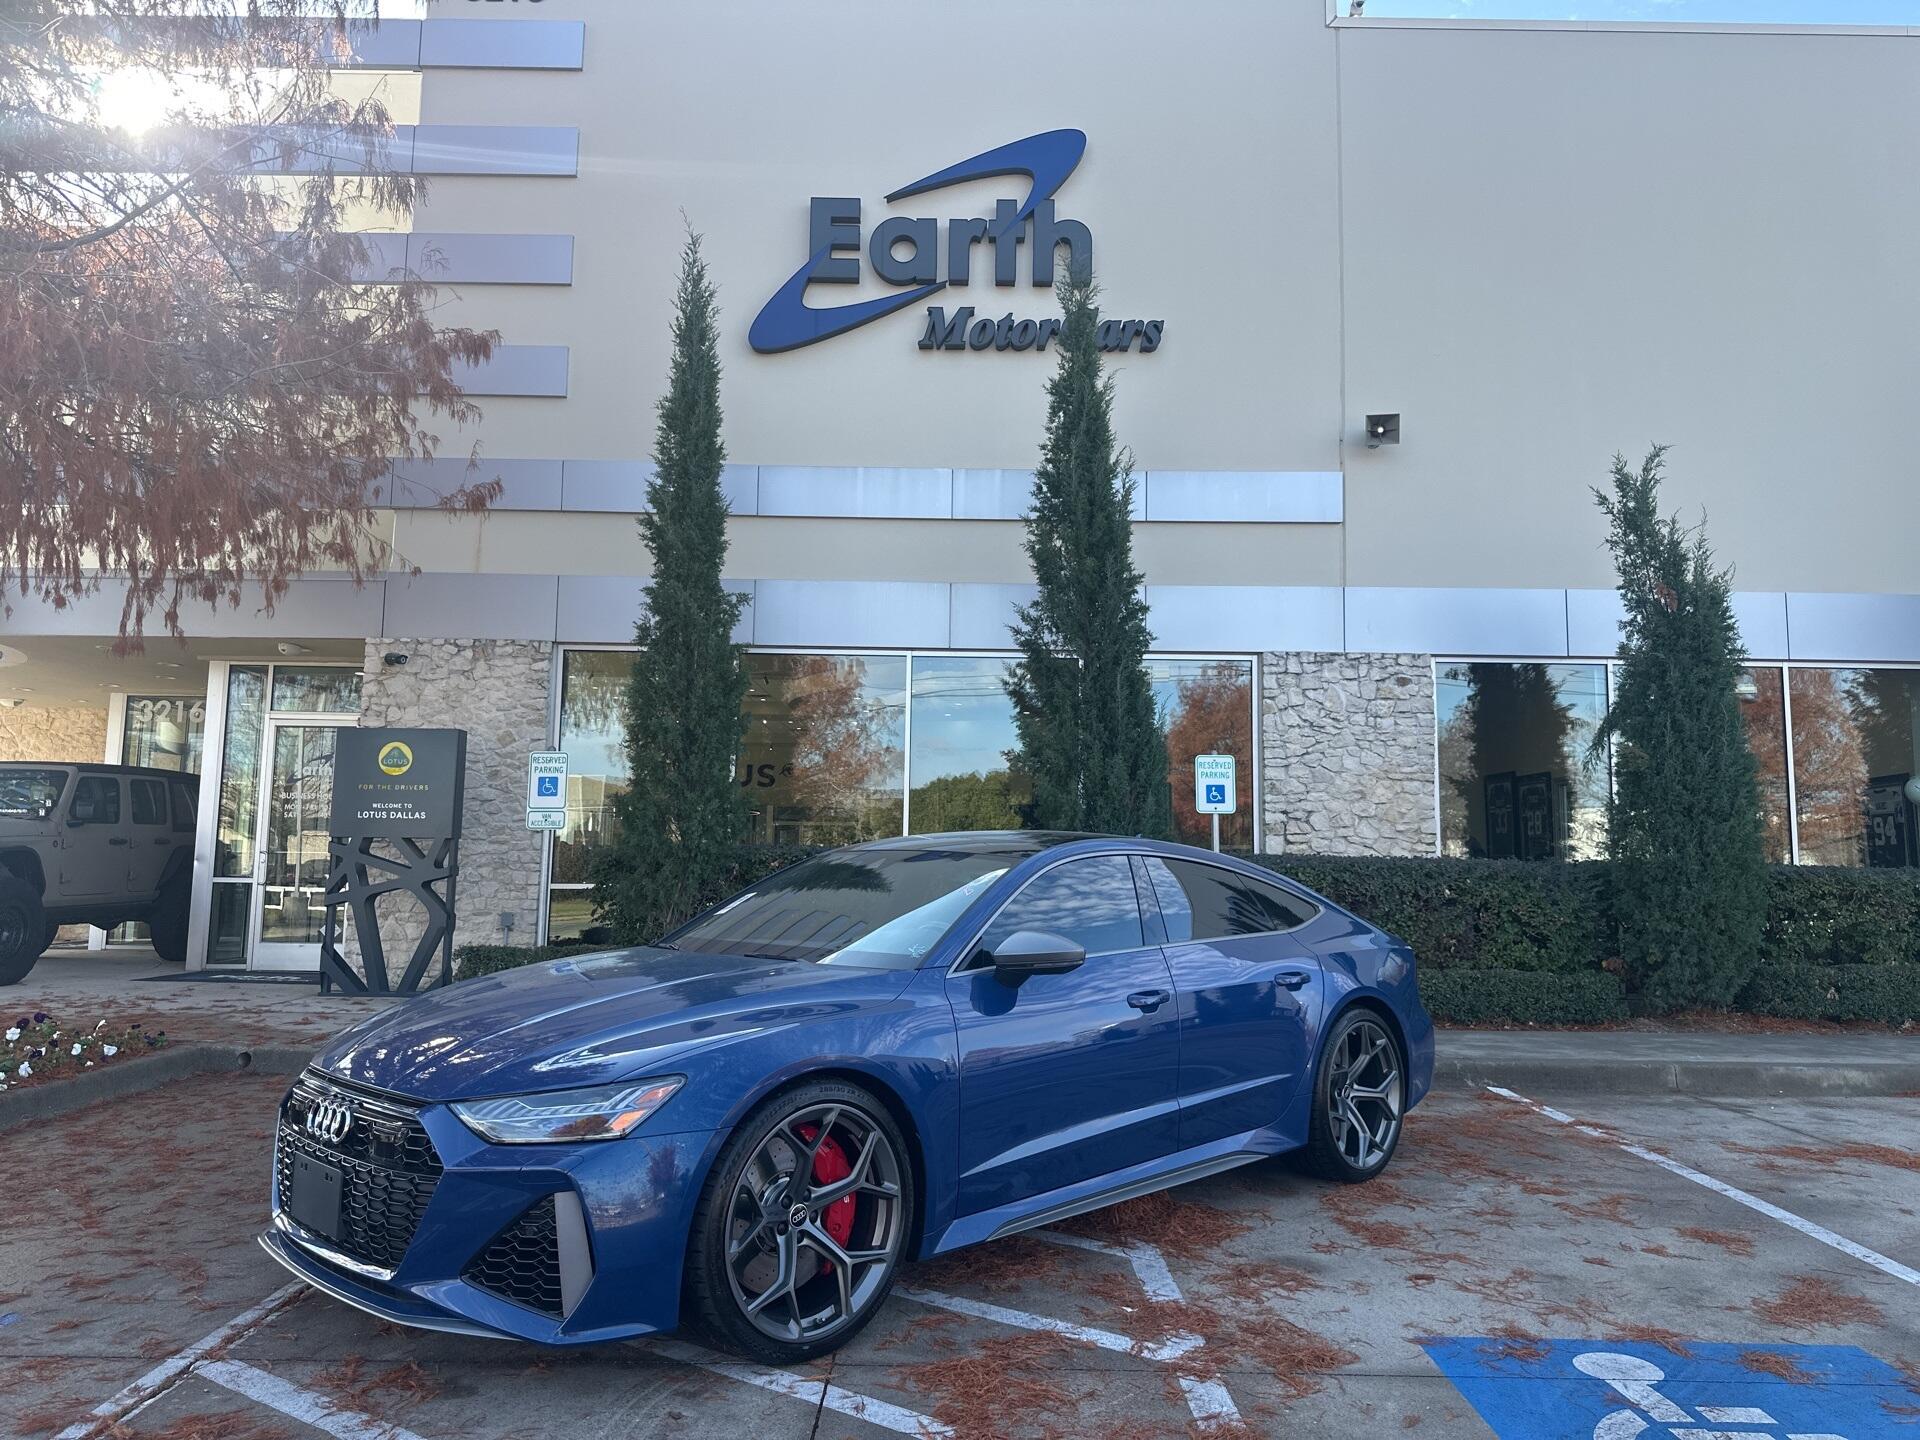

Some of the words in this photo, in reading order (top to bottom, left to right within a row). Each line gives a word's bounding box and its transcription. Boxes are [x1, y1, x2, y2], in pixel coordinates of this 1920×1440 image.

[809, 197, 1093, 289] Earth
[138, 699, 206, 723] 3216
[532, 756, 567, 765] RESERVED
[534, 766, 564, 774] PARKING
[1199, 761, 1232, 770] RESERVED
[1200, 771, 1230, 779] PARKING
[357, 811, 387, 819] LOTUS
[390, 811, 426, 820] DALLAS
[1873, 815, 1897, 847] 94
